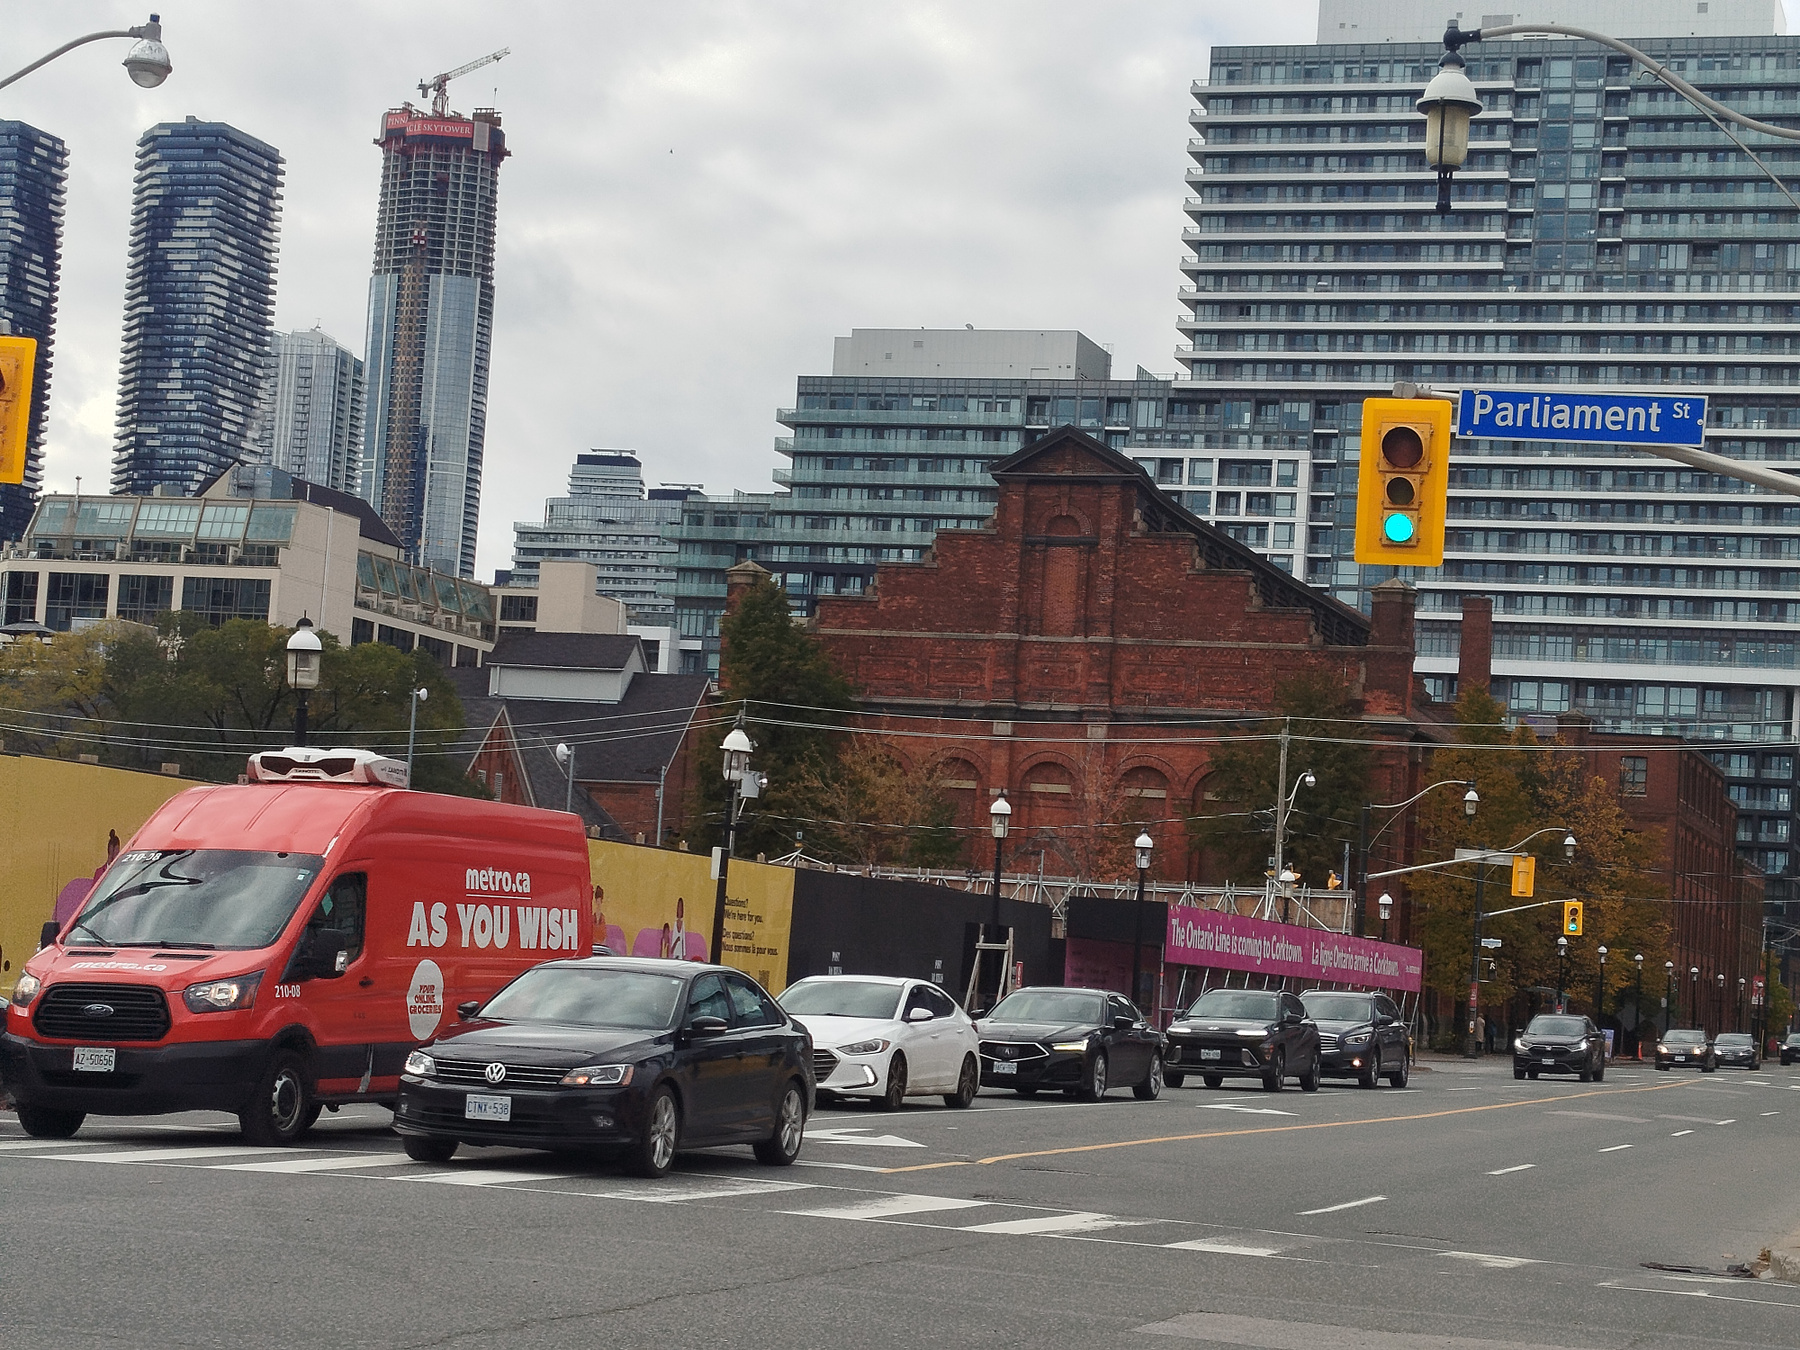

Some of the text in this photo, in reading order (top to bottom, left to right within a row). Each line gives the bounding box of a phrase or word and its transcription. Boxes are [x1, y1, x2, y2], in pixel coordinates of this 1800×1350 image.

[423, 124, 471, 134] SKYTOWER
[1473, 394, 1691, 432] Parliament St
[465, 867, 531, 893] metro.ca
[406, 901, 578, 950] AS YOU WISH
[1171, 918, 1303, 965] The Ontario Line is coming to Corktown.
[1311, 941, 1319, 965] La
[1320, 941, 1333, 973] ligne
[1333, 945, 1354, 970] Ontario
[1354, 949, 1370, 973] arrive
[1374, 952, 1399, 976] Corktown.
[70, 961, 167, 972] metro.ca
[274, 984, 301, 998] 210-08
[419, 985, 436, 994] YOUR
[414, 994, 436, 1004] ONLINE
[409, 1004, 442, 1014] GROCERIES
